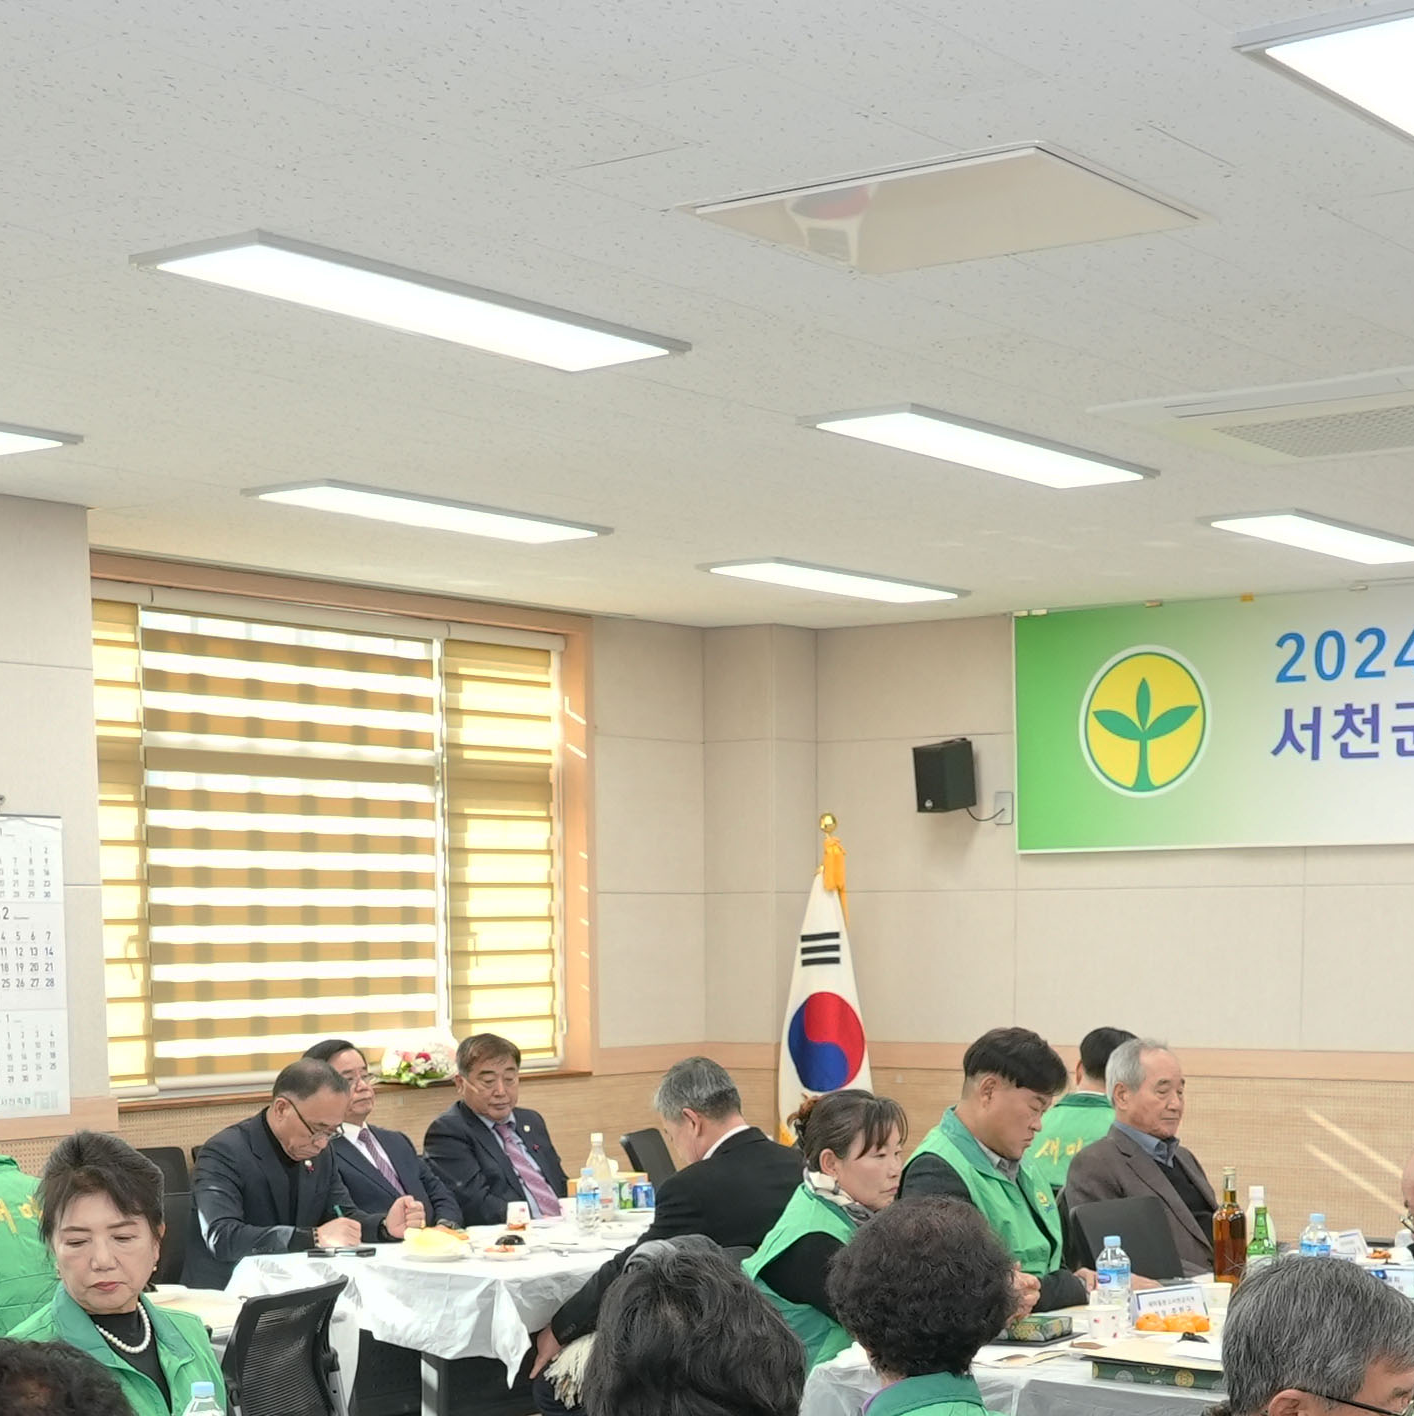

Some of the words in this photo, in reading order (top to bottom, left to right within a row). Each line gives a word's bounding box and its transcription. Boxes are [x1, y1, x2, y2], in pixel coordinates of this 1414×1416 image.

[16, 932, 20, 940] 5
[46, 931, 51, 940] 7
[0, 947, 7, 956] 11
[15, 947, 23, 956] 12
[30, 947, 38, 956] 13
[45, 947, 53, 955] 14
[1, 963, 9, 972] 18
[16, 963, 24, 971] 19
[30, 963, 39, 972] 20
[45, 963, 53, 971] 21
[2, 979, 10, 988] 25
[16, 979, 25, 988] 26
[31, 978, 39, 987] 27
[46, 978, 54, 987] 28
[1035, 1136, 1084, 1166] 새마
